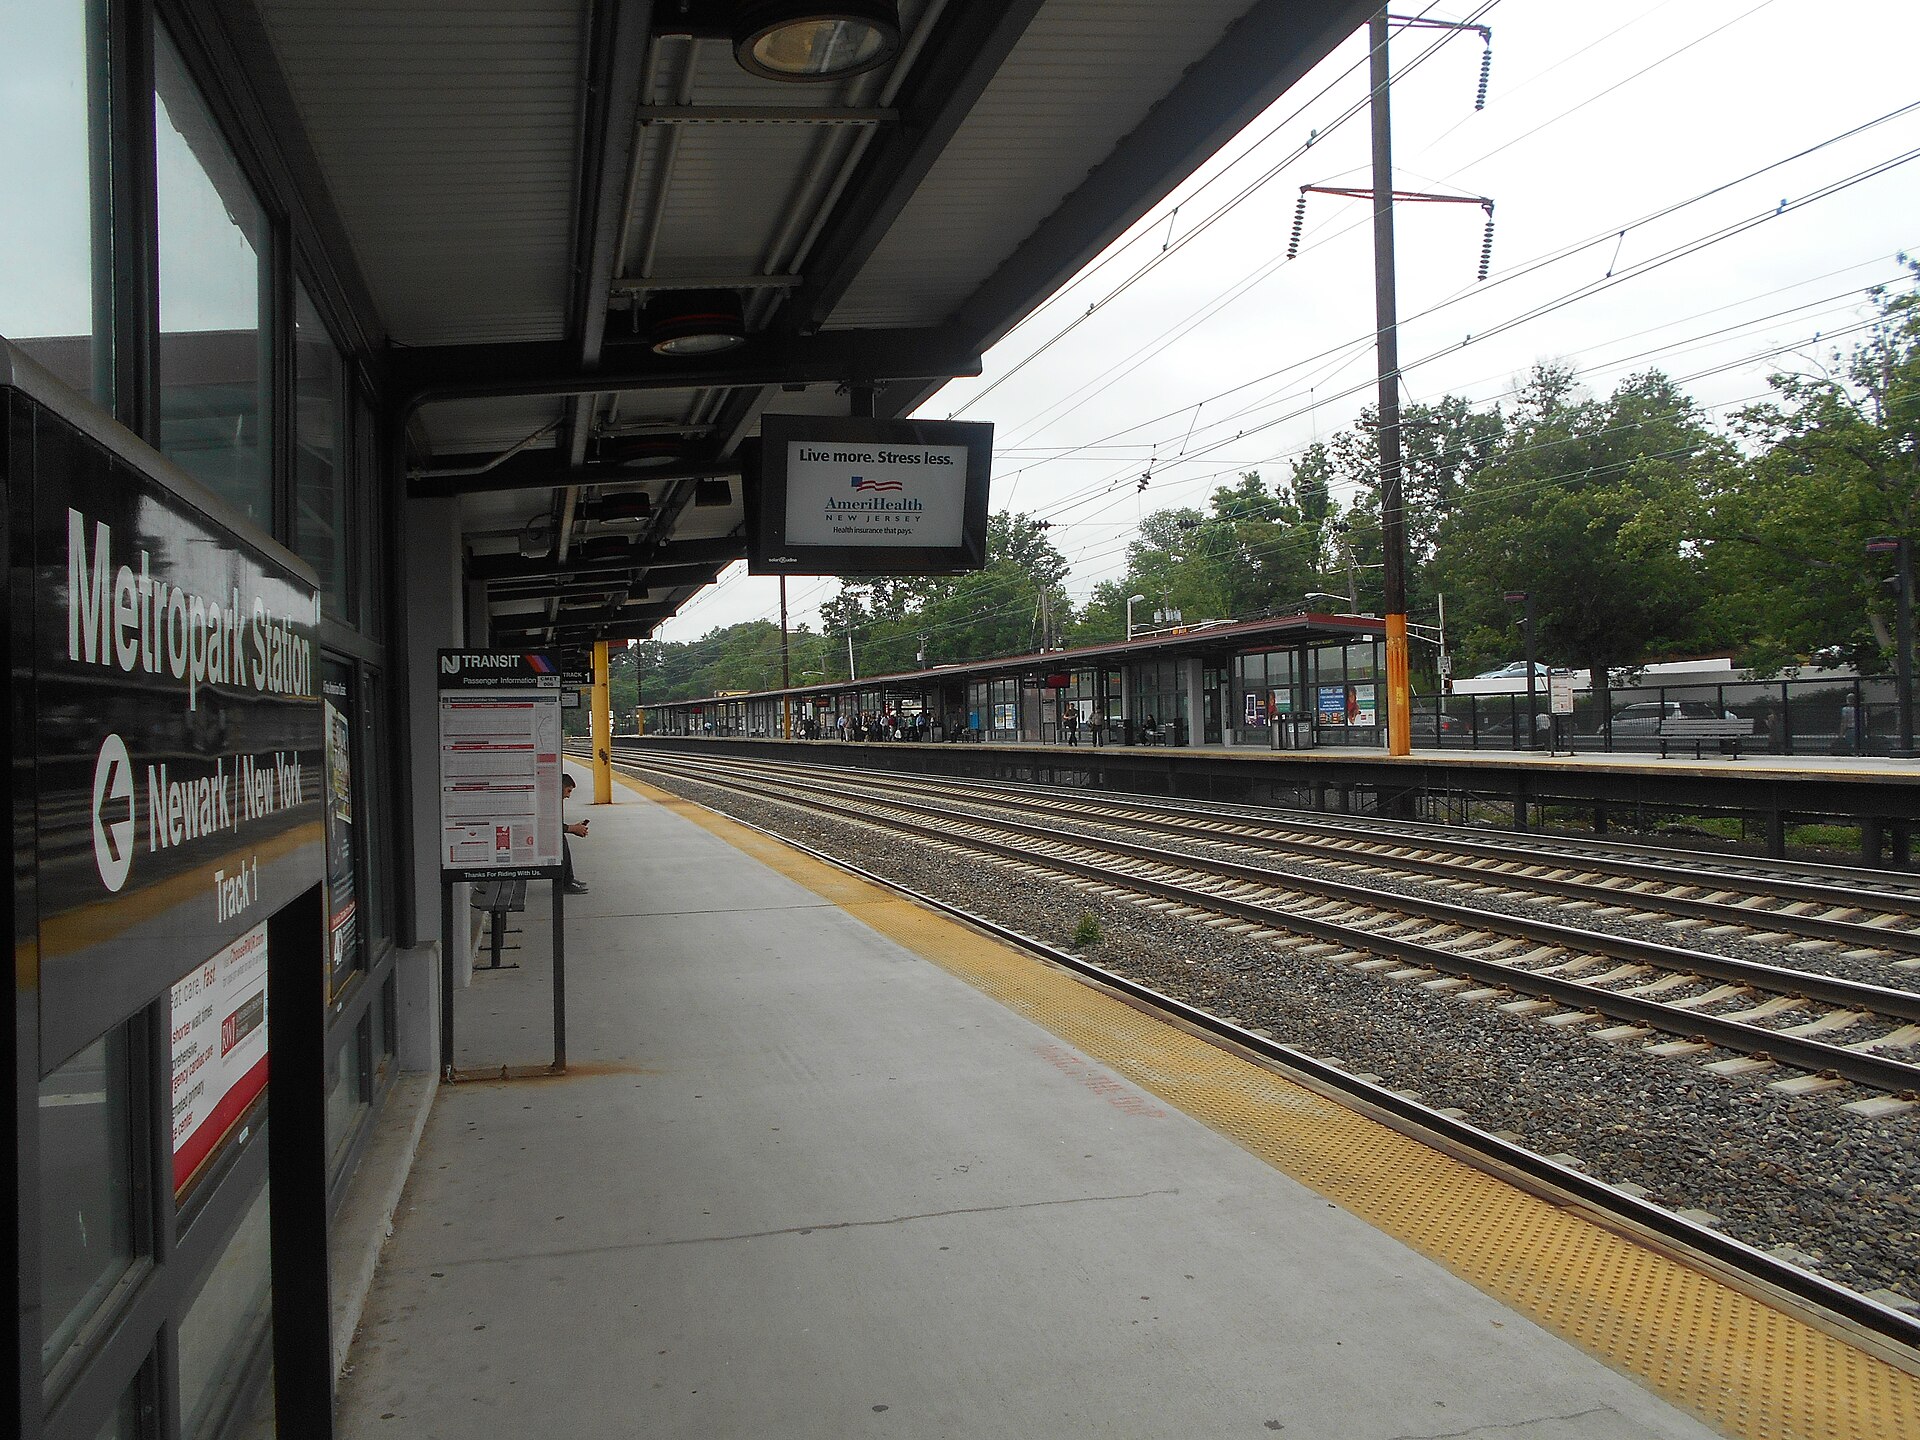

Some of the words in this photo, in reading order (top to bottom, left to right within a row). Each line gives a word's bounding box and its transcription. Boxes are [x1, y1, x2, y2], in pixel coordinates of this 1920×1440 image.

[800, 448, 829, 462] Live
[833, 452, 874, 463] more.
[877, 451, 921, 464] Stress
[924, 452, 954, 465] less.
[825, 496, 922, 511] AmeriHealth
[866, 515, 921, 523] JERSEY
[833, 526, 853, 534] Health
[854, 526, 883, 534] insurance
[884, 526, 897, 534] that
[68, 507, 247, 712] Metropark
[252, 596, 311, 696] Station
[441, 655, 460, 674] NJ
[462, 655, 520, 668] TRANSIT
[463, 677, 498, 685] Passenger
[500, 677, 537, 685] Information
[584, 672, 591, 683] 1
[148, 757, 230, 853] Newark
[243, 754, 274, 821] New
[275, 751, 303, 810] York
[215, 860, 250, 923] Track
[252, 855, 258, 901] 1
[184, 978, 201, 1003] care,
[173, 1020, 191, 1045] shorter
[191, 1009, 201, 1031] wait
[202, 1003, 213, 1022] times
[204, 1044, 213, 1062] care
[188, 1080, 204, 1109] primary
[178, 1111, 193, 1136] center
